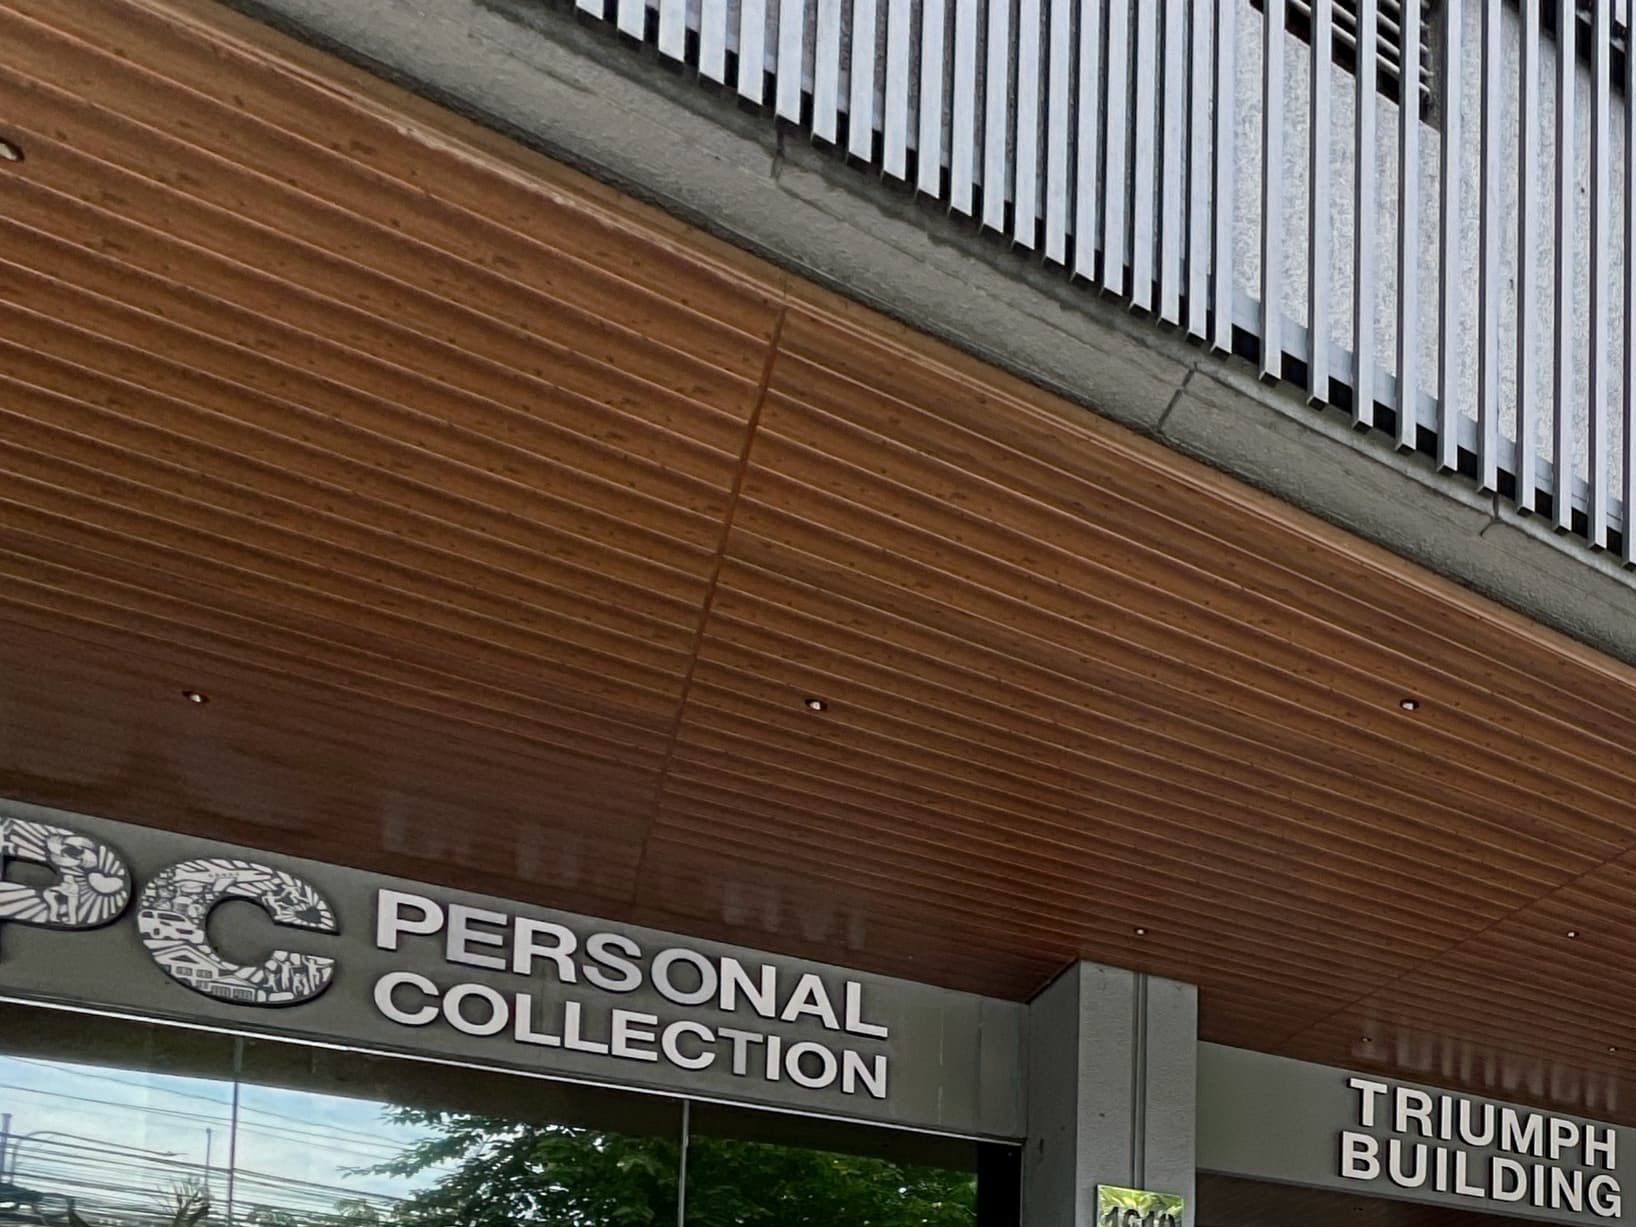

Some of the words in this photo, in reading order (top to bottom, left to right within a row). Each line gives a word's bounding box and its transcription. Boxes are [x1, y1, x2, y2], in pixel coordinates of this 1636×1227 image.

[376, 888, 889, 1040] PERSONAL
[373, 971, 889, 1099] COLLECTION
[1341, 1131, 1623, 1218] BUILDING
[1349, 1078, 1617, 1169] TRIUMPH
